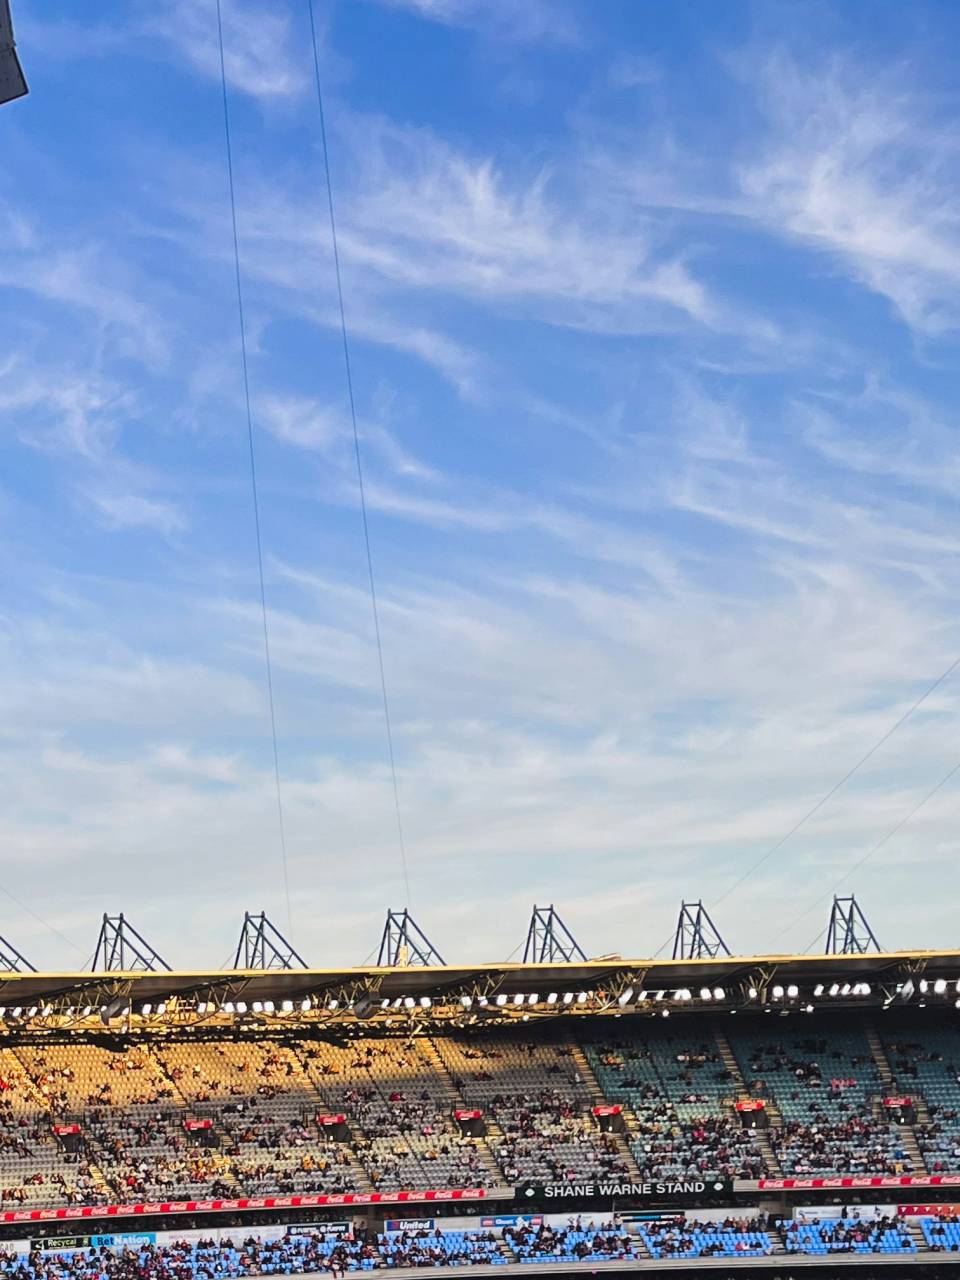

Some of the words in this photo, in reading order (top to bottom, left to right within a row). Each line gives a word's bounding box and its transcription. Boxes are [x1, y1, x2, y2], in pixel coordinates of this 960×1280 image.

[544, 1186, 594, 1198] SHANE
[600, 1184, 652, 1196] WARNE
[656, 1182, 705, 1194] STAND
